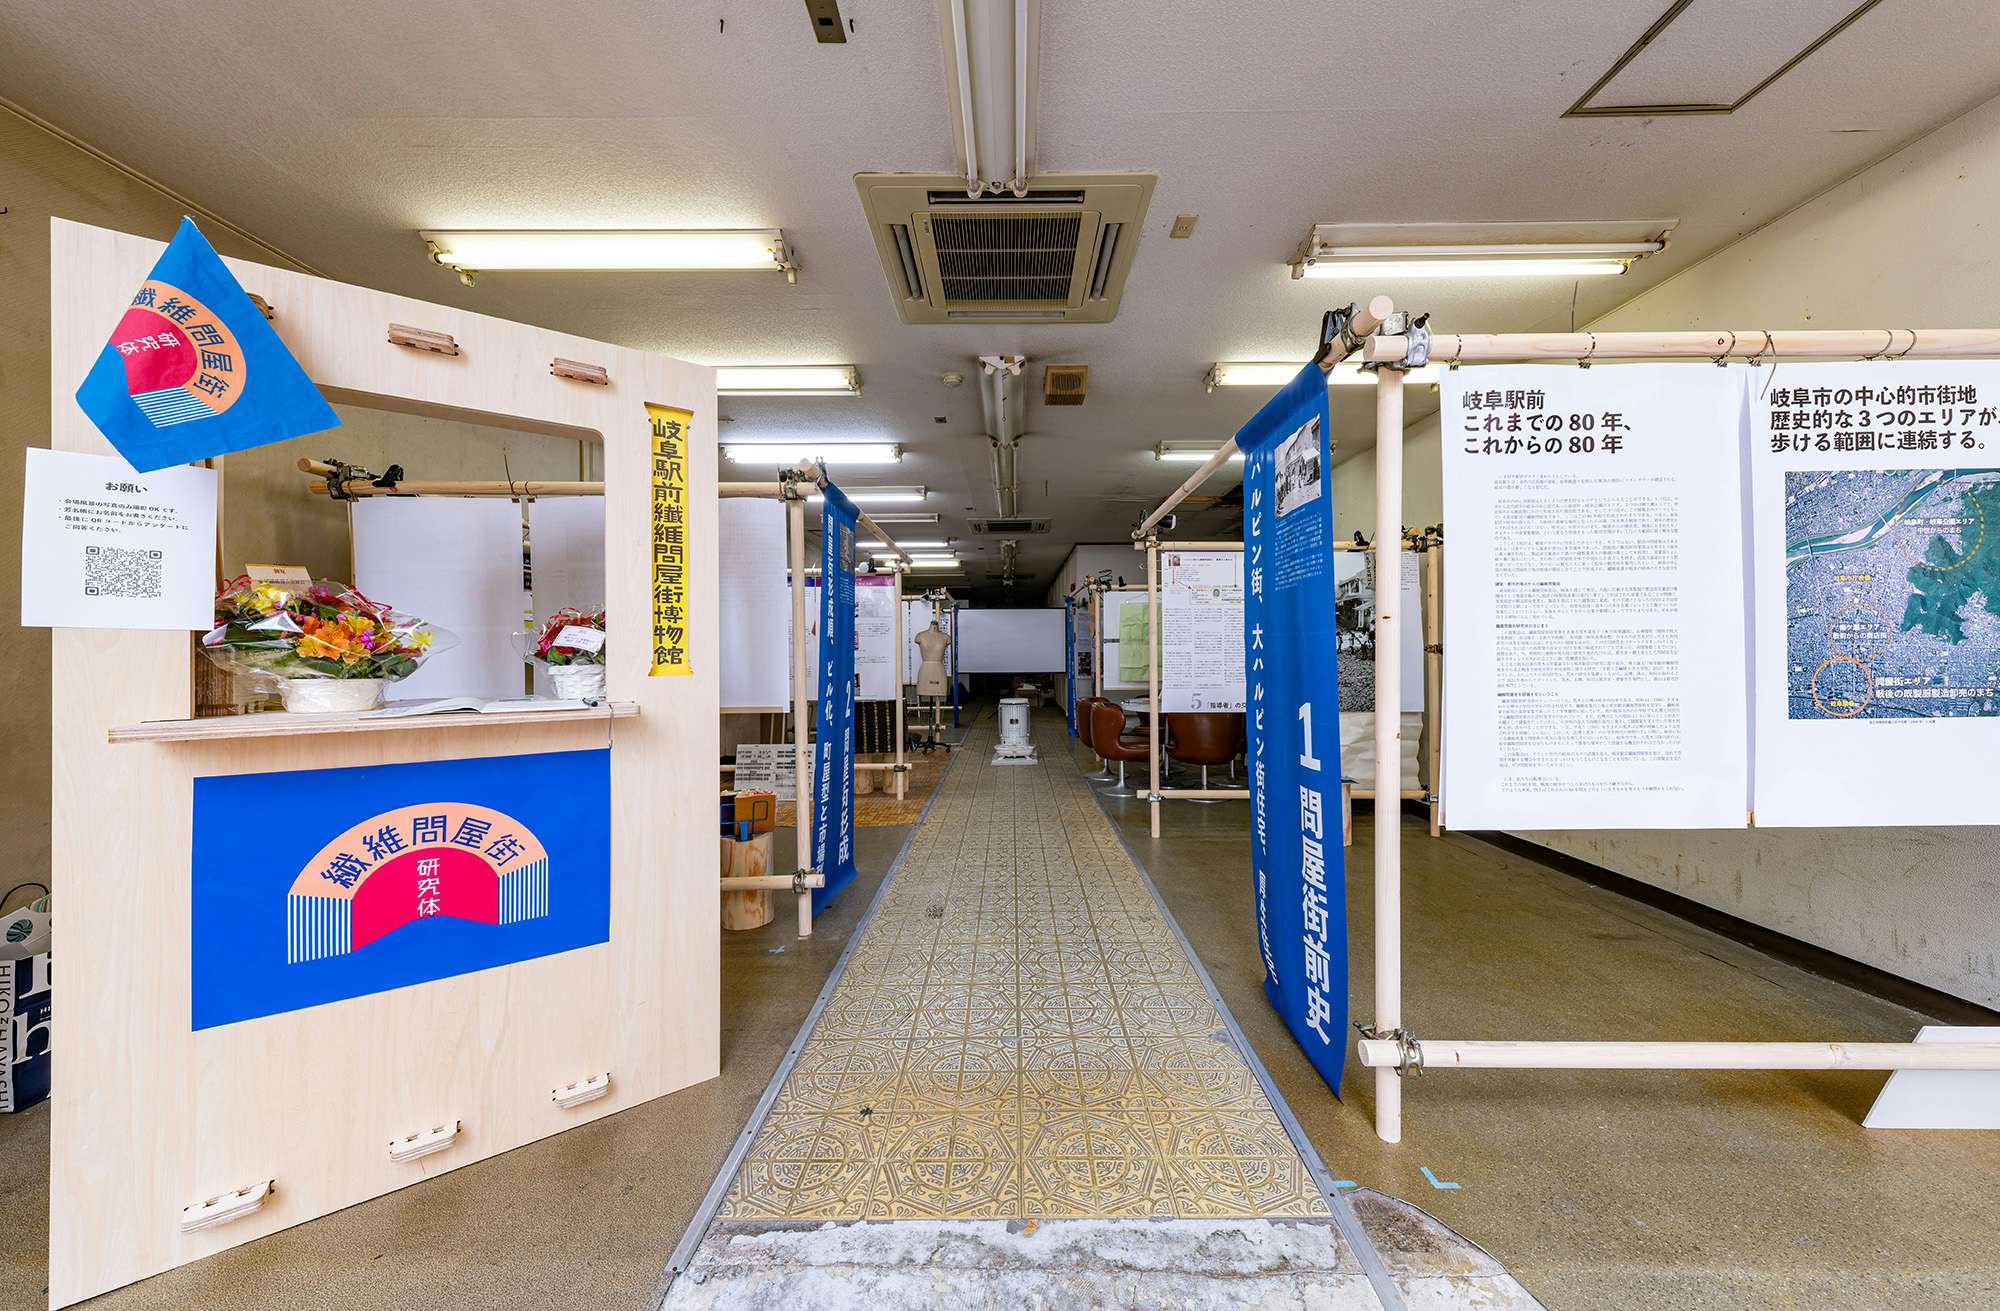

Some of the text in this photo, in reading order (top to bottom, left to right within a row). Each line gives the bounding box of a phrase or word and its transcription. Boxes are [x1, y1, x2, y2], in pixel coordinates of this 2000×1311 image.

[117, 332, 180, 355] 研究体
[1463, 390, 1546, 410] 岐阜駅前
[1770, 385, 1978, 408] 岐阜市の中心的市街地
[1770, 408, 2000, 430] 歴史的な3つのエリアが
[1770, 431, 1984, 452] 歩ける範囲に連続する。
[105, 482, 148, 493] お願い
[653, 419, 683, 665] 岐阜駅前繊維問屋街博物館
[845, 680, 851, 719] 2
[320, 815, 526, 889] 繊維問屋街
[1299, 702, 1331, 1046] 1 問屋街前史
[417, 858, 440, 917] 研究体
